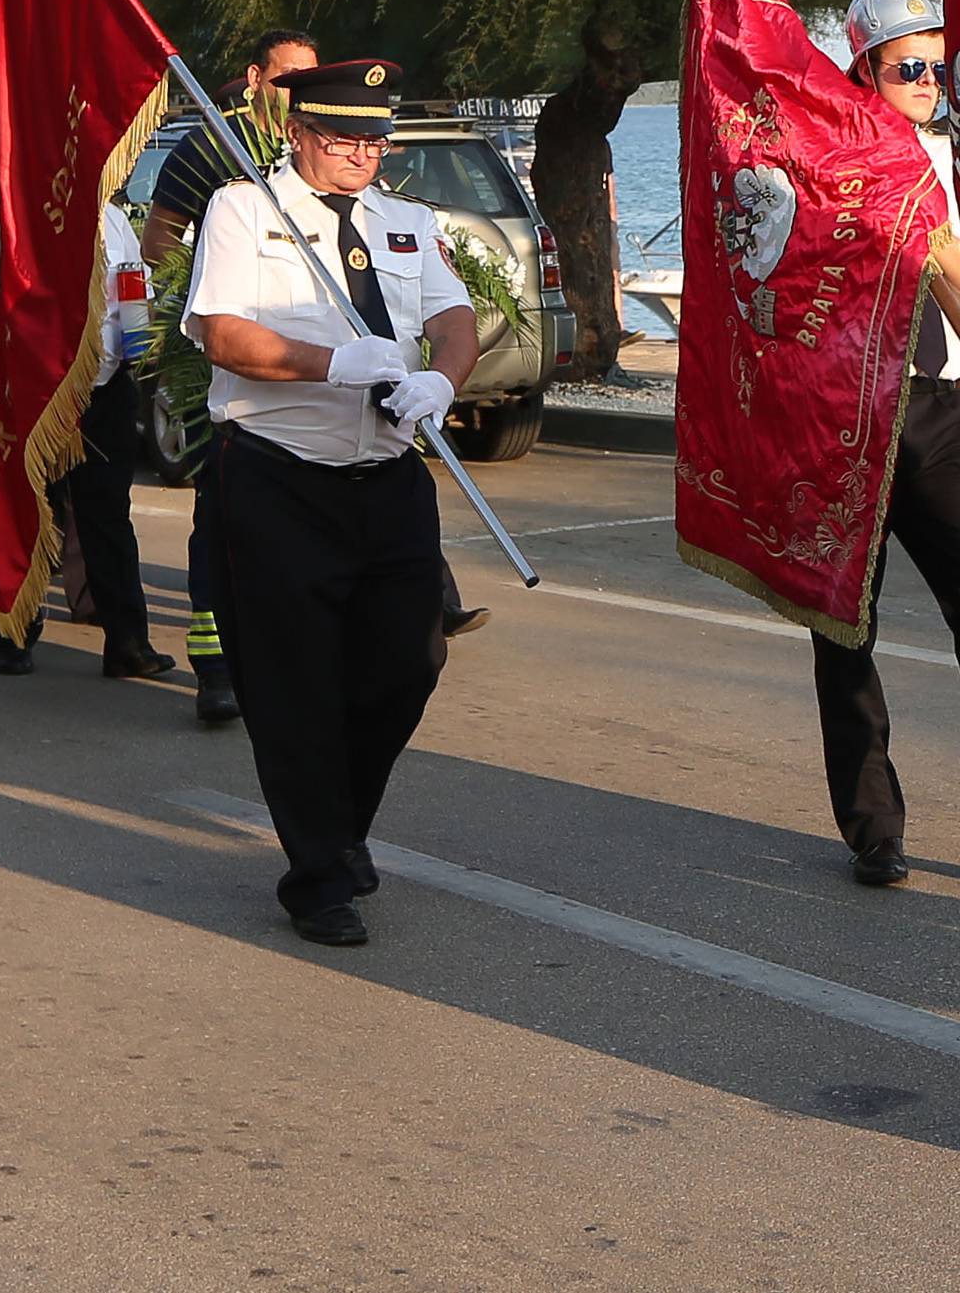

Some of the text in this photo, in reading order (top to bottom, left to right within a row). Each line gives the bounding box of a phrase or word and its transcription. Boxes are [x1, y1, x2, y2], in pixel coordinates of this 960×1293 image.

[458, 97, 494, 117] RENT
[499, 98, 510, 117] A
[796, 167, 864, 348] BRATA SPASI
